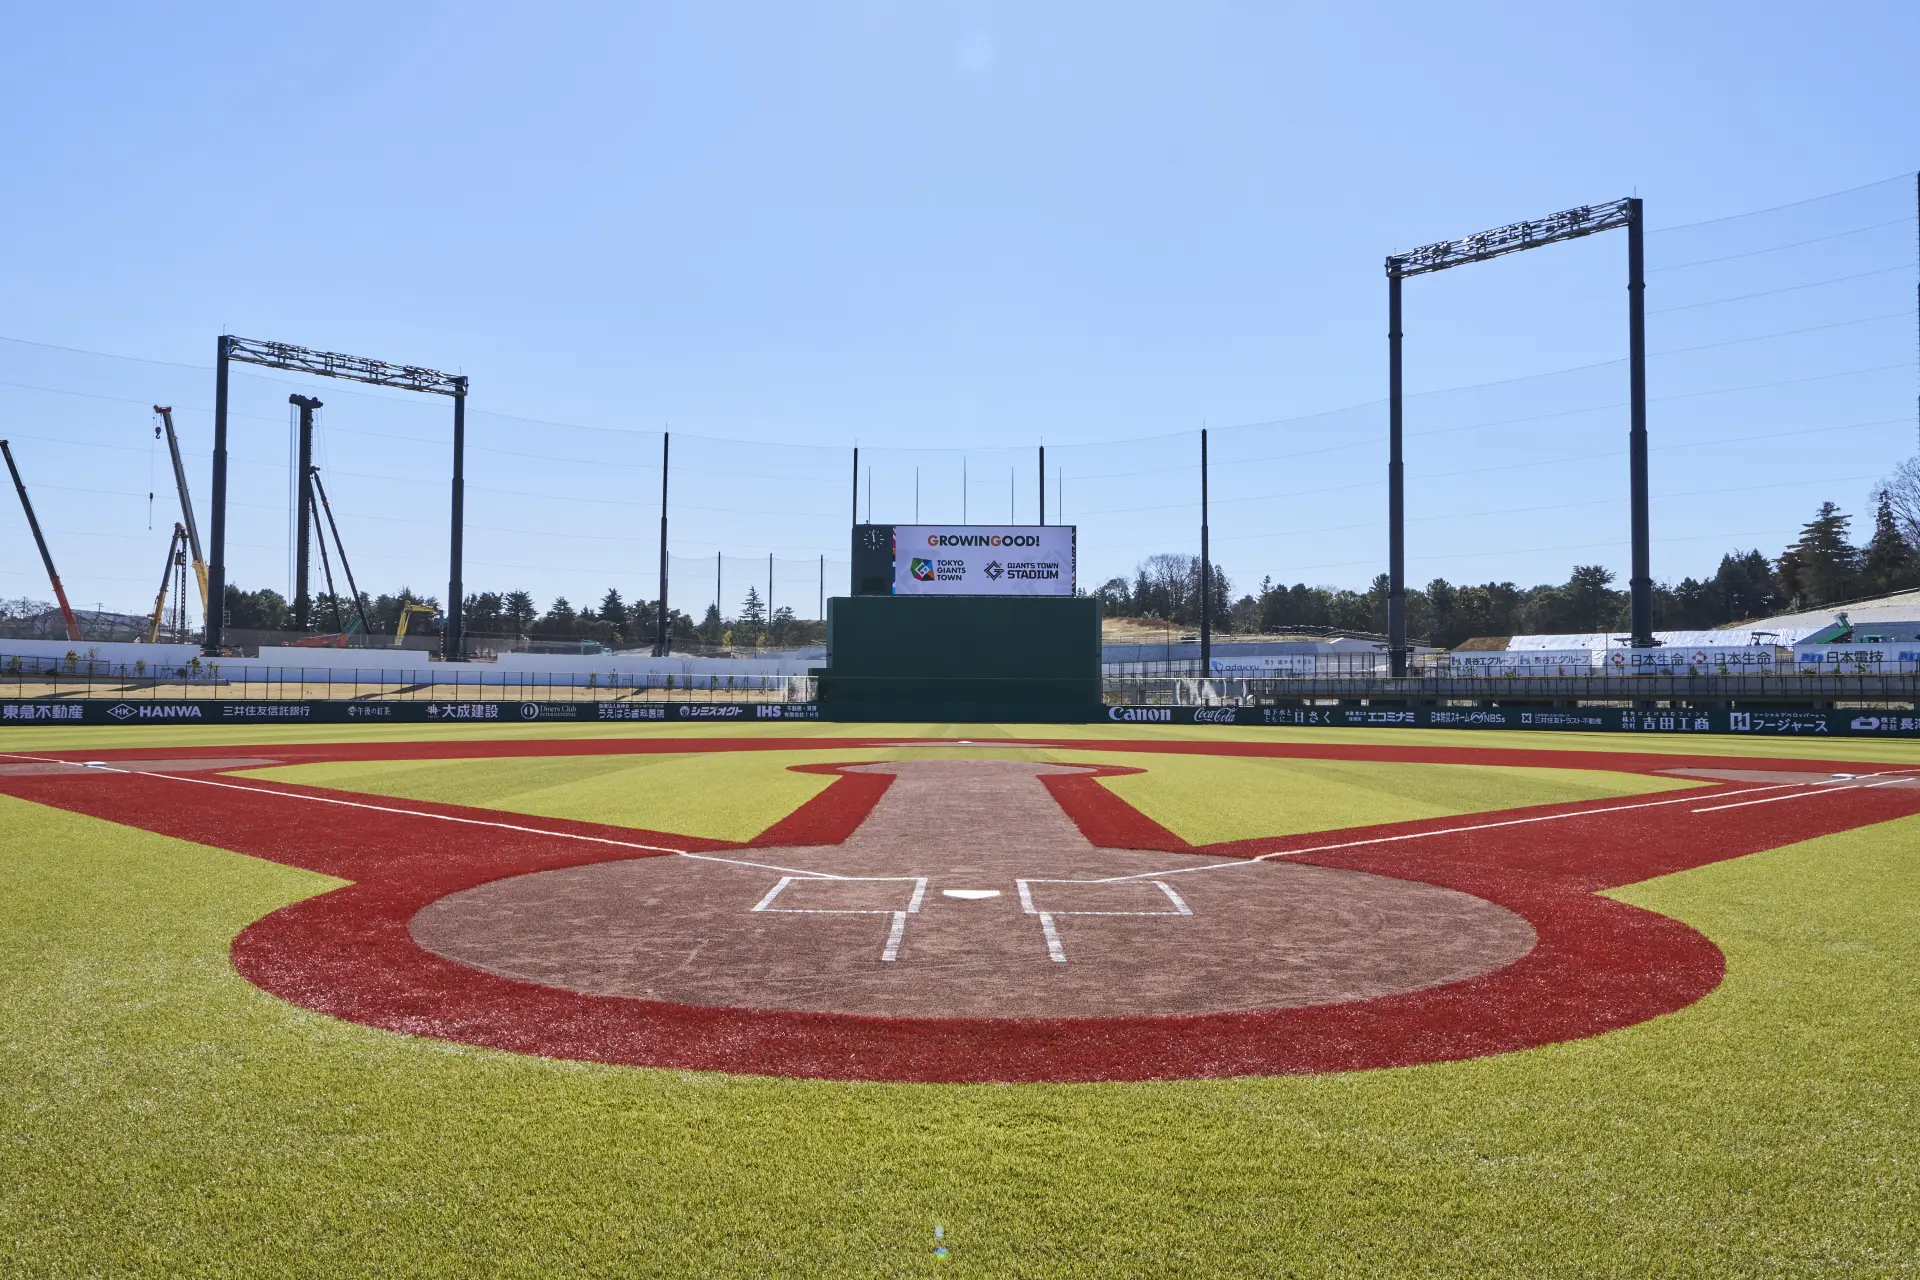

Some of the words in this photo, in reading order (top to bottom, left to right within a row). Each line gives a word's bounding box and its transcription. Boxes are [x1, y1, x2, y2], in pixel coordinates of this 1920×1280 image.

[927, 535, 1040, 547] GROWINGOOD!
[937, 559, 964, 567] TOKYO
[1007, 569, 1059, 580] STADIUM
[1464, 656, 1518, 666] 長谷工グループ
[1534, 654, 1591, 665] 長谷工グループ
[1631, 653, 1685, 667] 日本生命
[1714, 652, 1772, 666] 日本生命
[1827, 650, 1884, 664] 日本電技
[3, 705, 83, 719] 東急不動産
[115, 708, 129, 716] HK
[139, 705, 202, 718] HANWA
[223, 705, 310, 716] 三井住友信託銀行
[357, 706, 392, 716] 午後の紅茶
[442, 704, 499, 718] 大成建設
[540, 704, 559, 713] Diners
[561, 704, 577, 713] Club
[598, 708, 665, 719] うえはら歯科医院
[691, 706, 743, 716] シミズオクト
[756, 705, 782, 718] IHS
[1108, 706, 1171, 721] Canon
[1263, 708, 1292, 716] 地下水と
[1294, 710, 1330, 724] 日さく
[1367, 711, 1415, 722] エコミナミ
[1642, 716, 1710, 731] 吉田工商
[1753, 718, 1828, 732] フージャース
[1880, 723, 1898, 731] 会社
